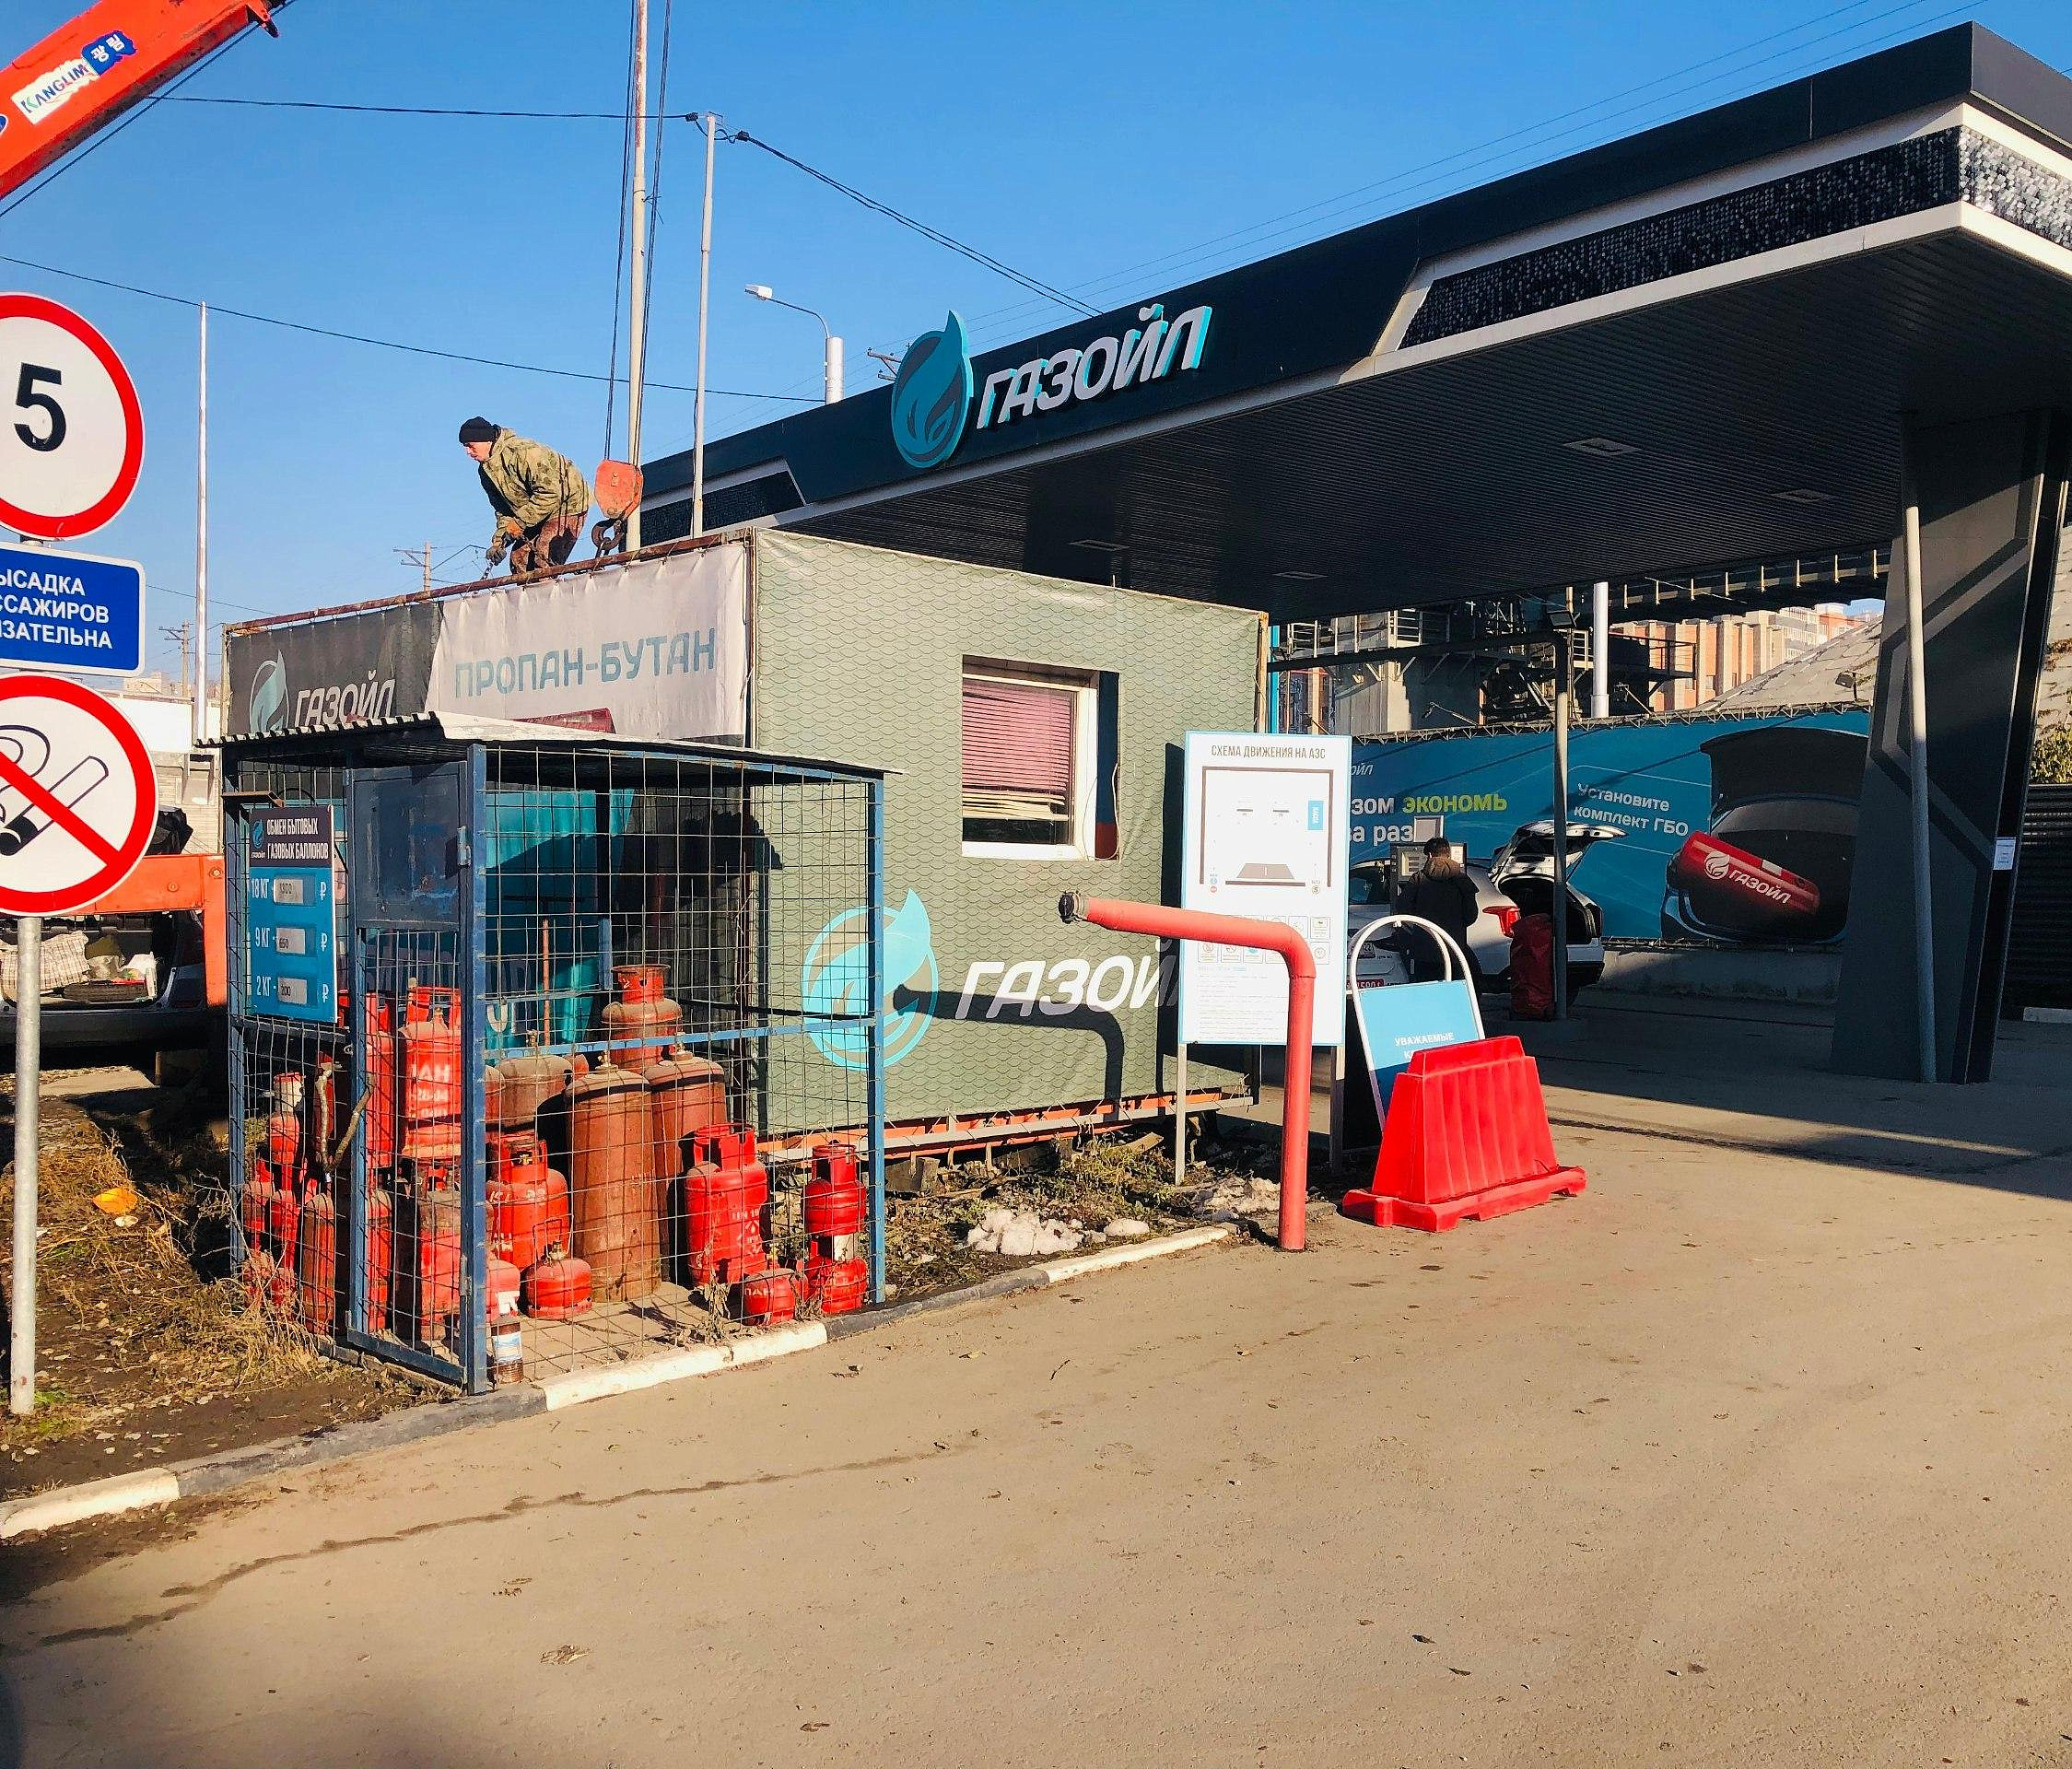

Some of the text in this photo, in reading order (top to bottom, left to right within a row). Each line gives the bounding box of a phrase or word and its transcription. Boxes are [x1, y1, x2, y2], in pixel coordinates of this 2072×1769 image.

[20, 64, 89, 113] KANGLIM
[977, 303, 1212, 429] ГАЗОЙЛ
[14, 362, 66, 451] 5
[0, 620, 112, 649] ЗАТЕЛЬНА
[454, 627, 716, 698] ПРОПАН-БУТАН
[295, 670, 395, 727] ГАЗОЙЛ
[1212, 744, 1326, 759] СХЕМА ДВИЖЕНИЯ НА АЗС
[1578, 783, 1670, 812] Установите
[266, 818, 319, 835] ОБМЕН БЫТОВЫХ
[1574, 806, 1689, 837] комплект ГБО
[267, 843, 329, 860] ГАЗОВЫХ БАЛЛОНОВ
[1728, 869, 1791, 904] ГАЗОЙЛ
[255, 926, 261, 948] 9
[257, 975, 262, 996] 2
[954, 939, 1179, 1019] ГАЗОЙ
[1395, 1032, 1455, 1047] УВАЖАЕМЫЕ
